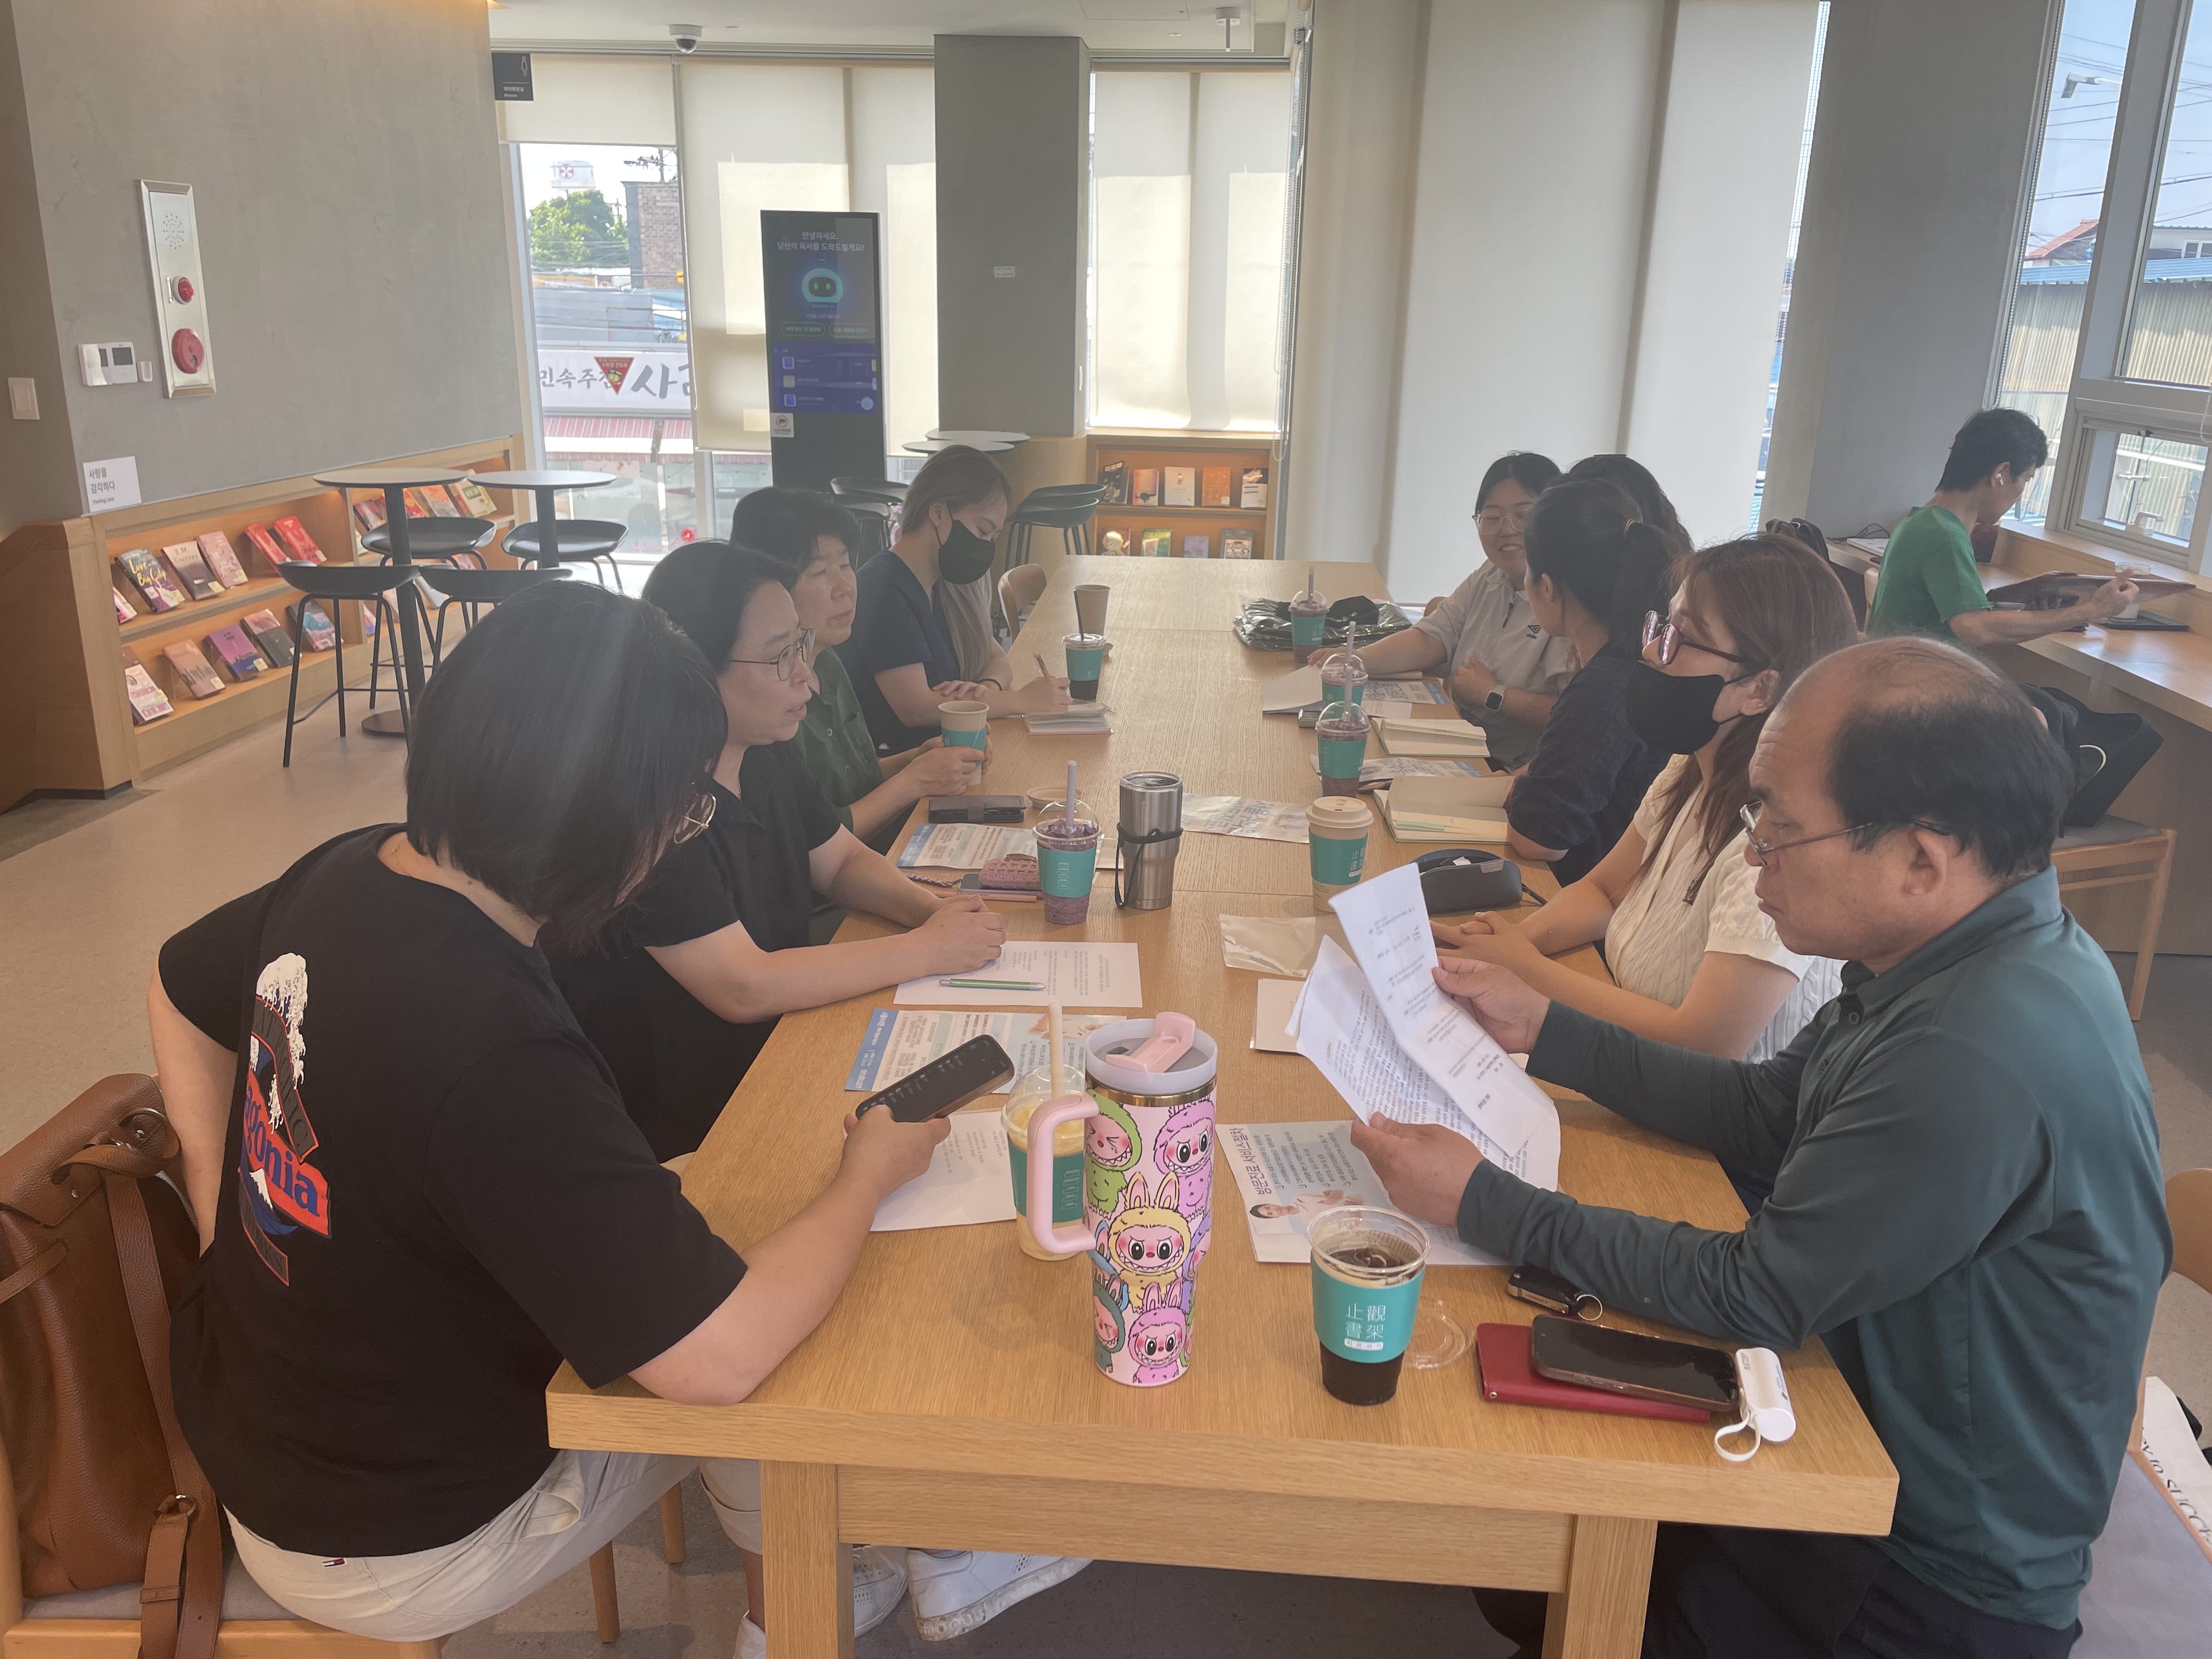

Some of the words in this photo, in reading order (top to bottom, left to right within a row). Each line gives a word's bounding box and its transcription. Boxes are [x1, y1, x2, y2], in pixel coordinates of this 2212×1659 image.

[802, 232, 839, 240] 안녕하세요.
[777, 242, 797, 250] 당신의
[799, 242, 819, 251] 독서를
[821, 243, 865, 251] 도와드릴게요!
[89, 467, 107, 479] 사랑을
[91, 480, 115, 494] 감각하다
[128, 558, 148, 574] Love
[137, 572, 153, 586] Big
[150, 567, 167, 582] City
[1228, 1128, 1258, 1164] 서비스절차
[1244, 1164, 1272, 1195] 방문진료
